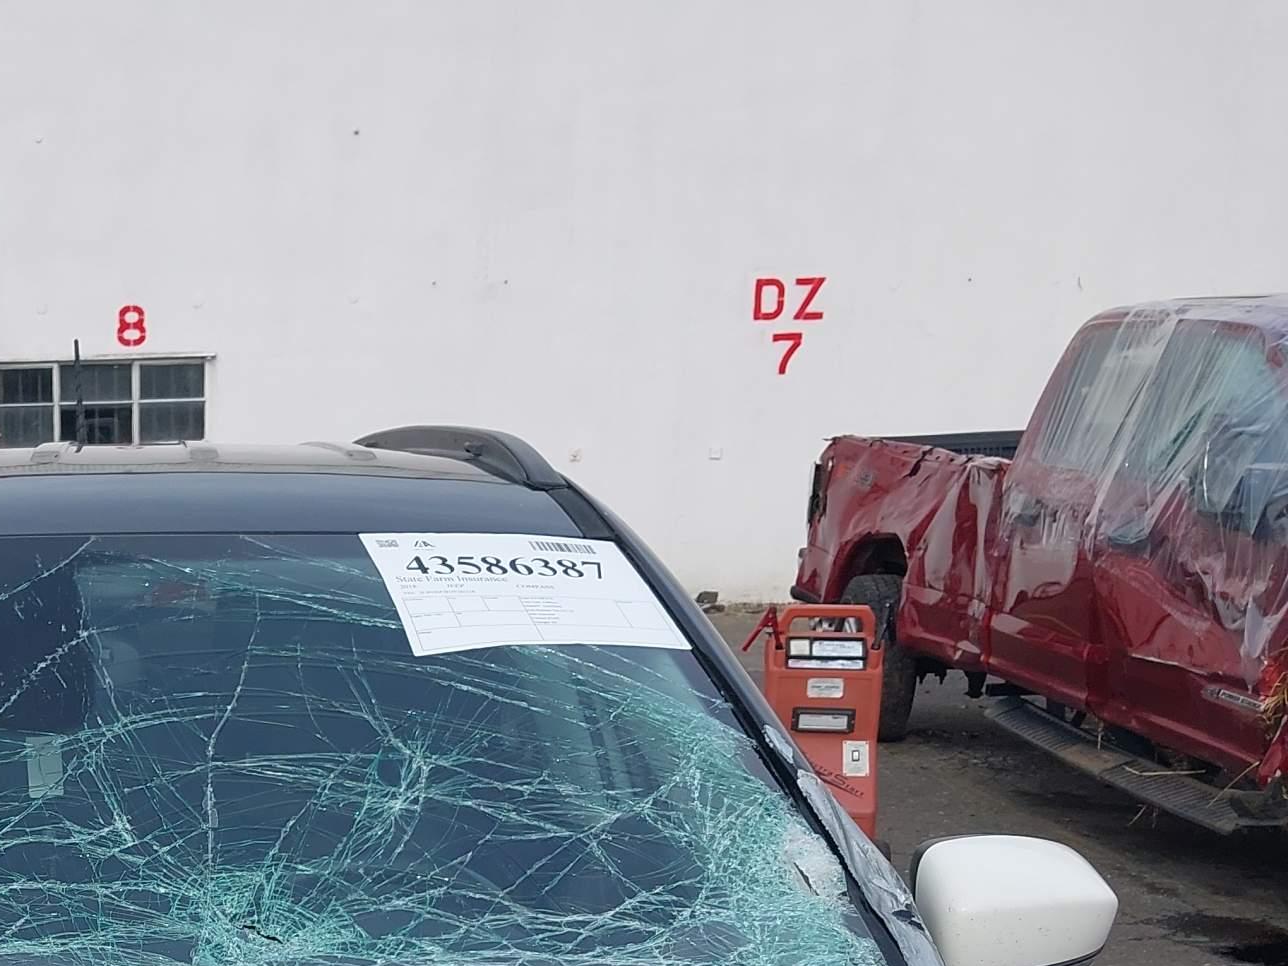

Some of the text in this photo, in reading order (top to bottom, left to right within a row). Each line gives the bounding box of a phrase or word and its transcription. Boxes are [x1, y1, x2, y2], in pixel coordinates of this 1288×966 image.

[752, 277, 824, 322] DZ
[117, 305, 147, 347] 8
[772, 332, 804, 374] 7
[395, 575, 508, 583] State Farm Insurance
[406, 555, 602, 580] 43586387
